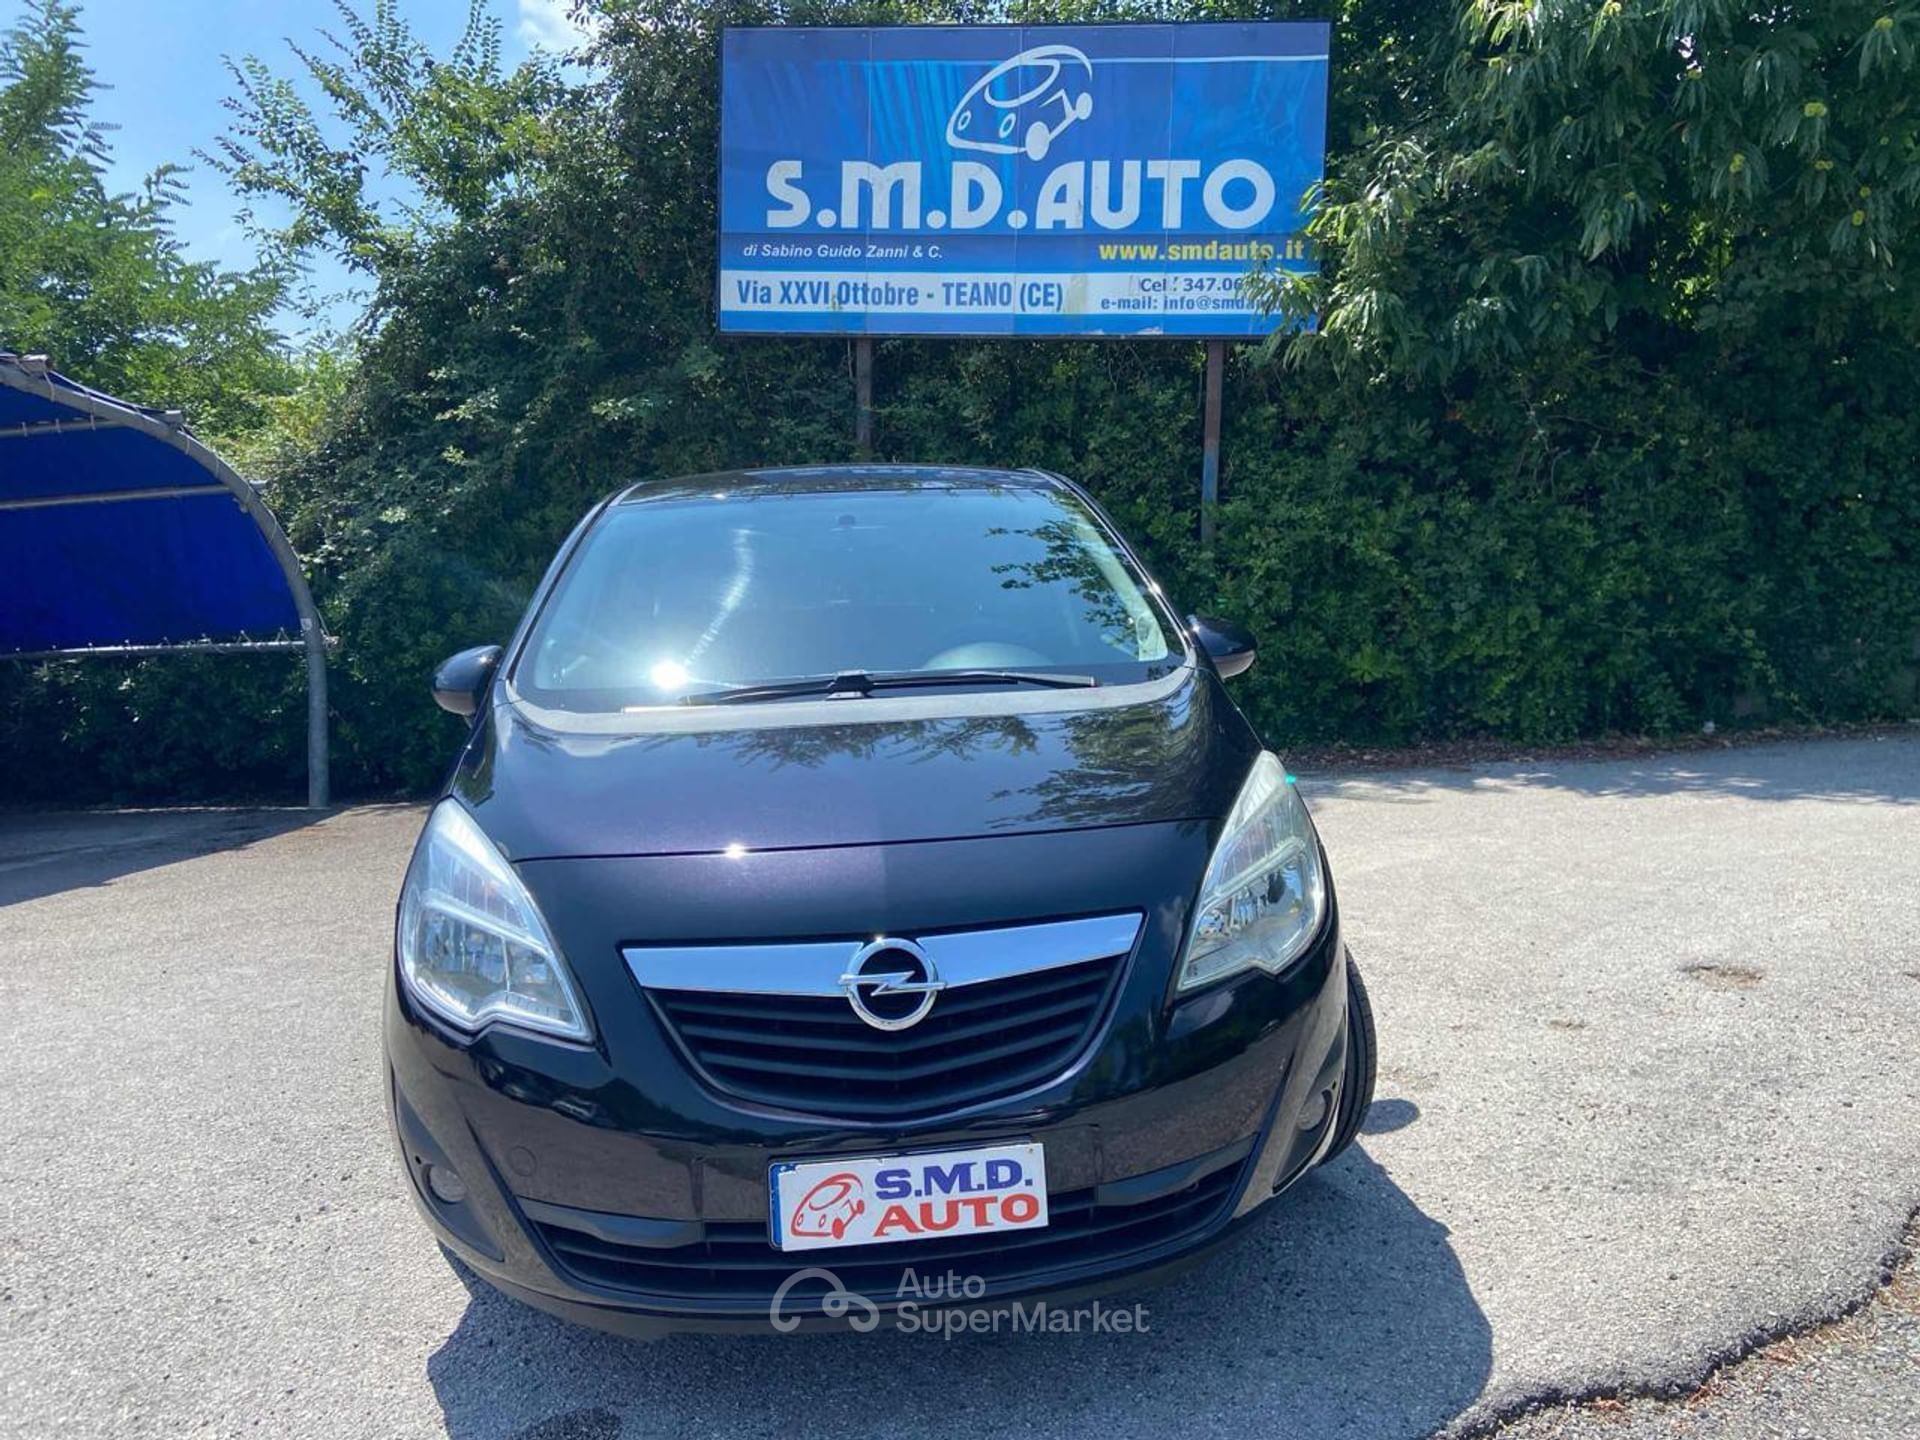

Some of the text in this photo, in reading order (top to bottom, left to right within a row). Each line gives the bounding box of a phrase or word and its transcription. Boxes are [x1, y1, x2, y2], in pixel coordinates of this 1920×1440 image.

[743, 244, 943, 259] di Sabino Guido Zanni & C.
[1099, 240, 1304, 261] www.smdauto.it
[737, 280, 772, 304] Via
[779, 281, 830, 305] XXVI
[837, 281, 919, 306] Ottobre
[942, 281, 1012, 307] TEANO
[1020, 282, 1063, 312] (CE)
[1101, 296, 1159, 310] e-mail:
[874, 1159, 1033, 1200] S.M.D.
[873, 1193, 1040, 1237] AUTO
